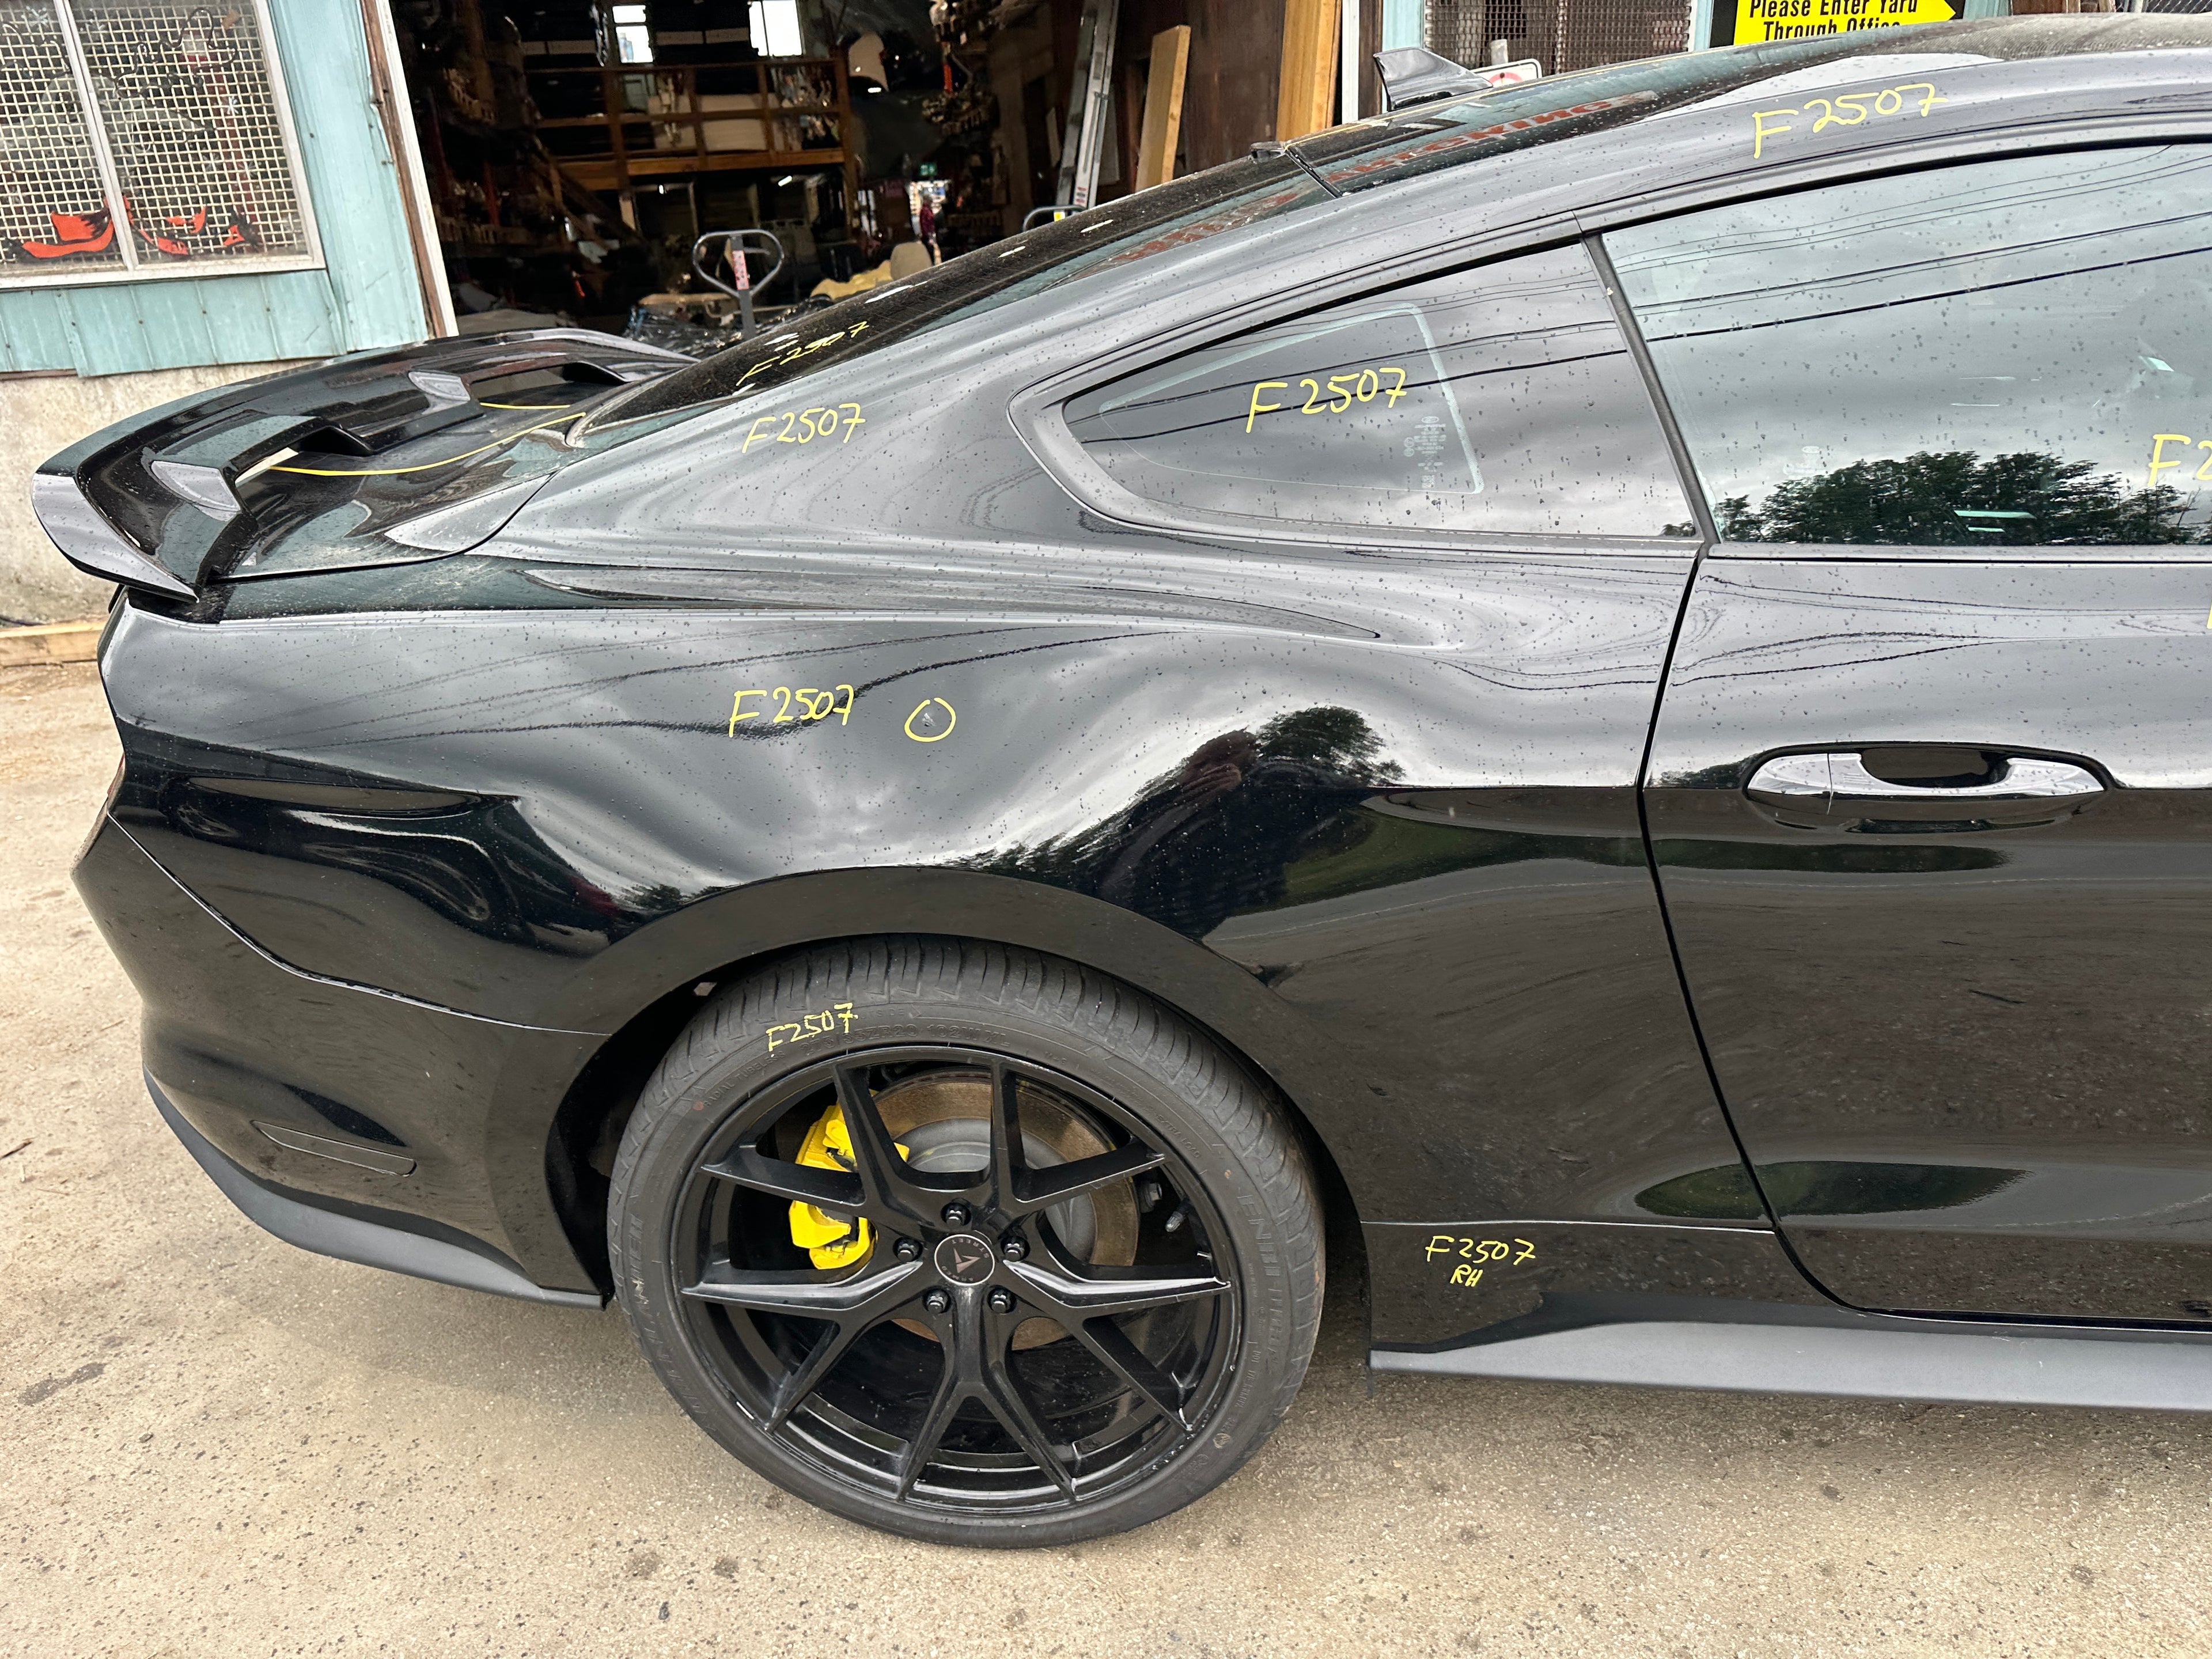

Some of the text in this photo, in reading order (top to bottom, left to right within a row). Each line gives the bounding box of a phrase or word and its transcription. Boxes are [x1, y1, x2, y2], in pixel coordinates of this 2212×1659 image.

[1749, 0, 1811, 18] Please
[1820, 0, 1869, 16] Enter
[1847, 17, 1900, 32] Offi
[1752, 83, 1949, 159] F2507
[736, 321, 869, 386] F2507
[1245, 367, 1407, 433] F2507
[741, 403, 865, 453] F2507
[728, 684, 854, 737] F2507
[766, 1002, 858, 1052] F2507
[1424, 1234, 1537, 1266] F2507
[1449, 1264, 1484, 1287] RH
